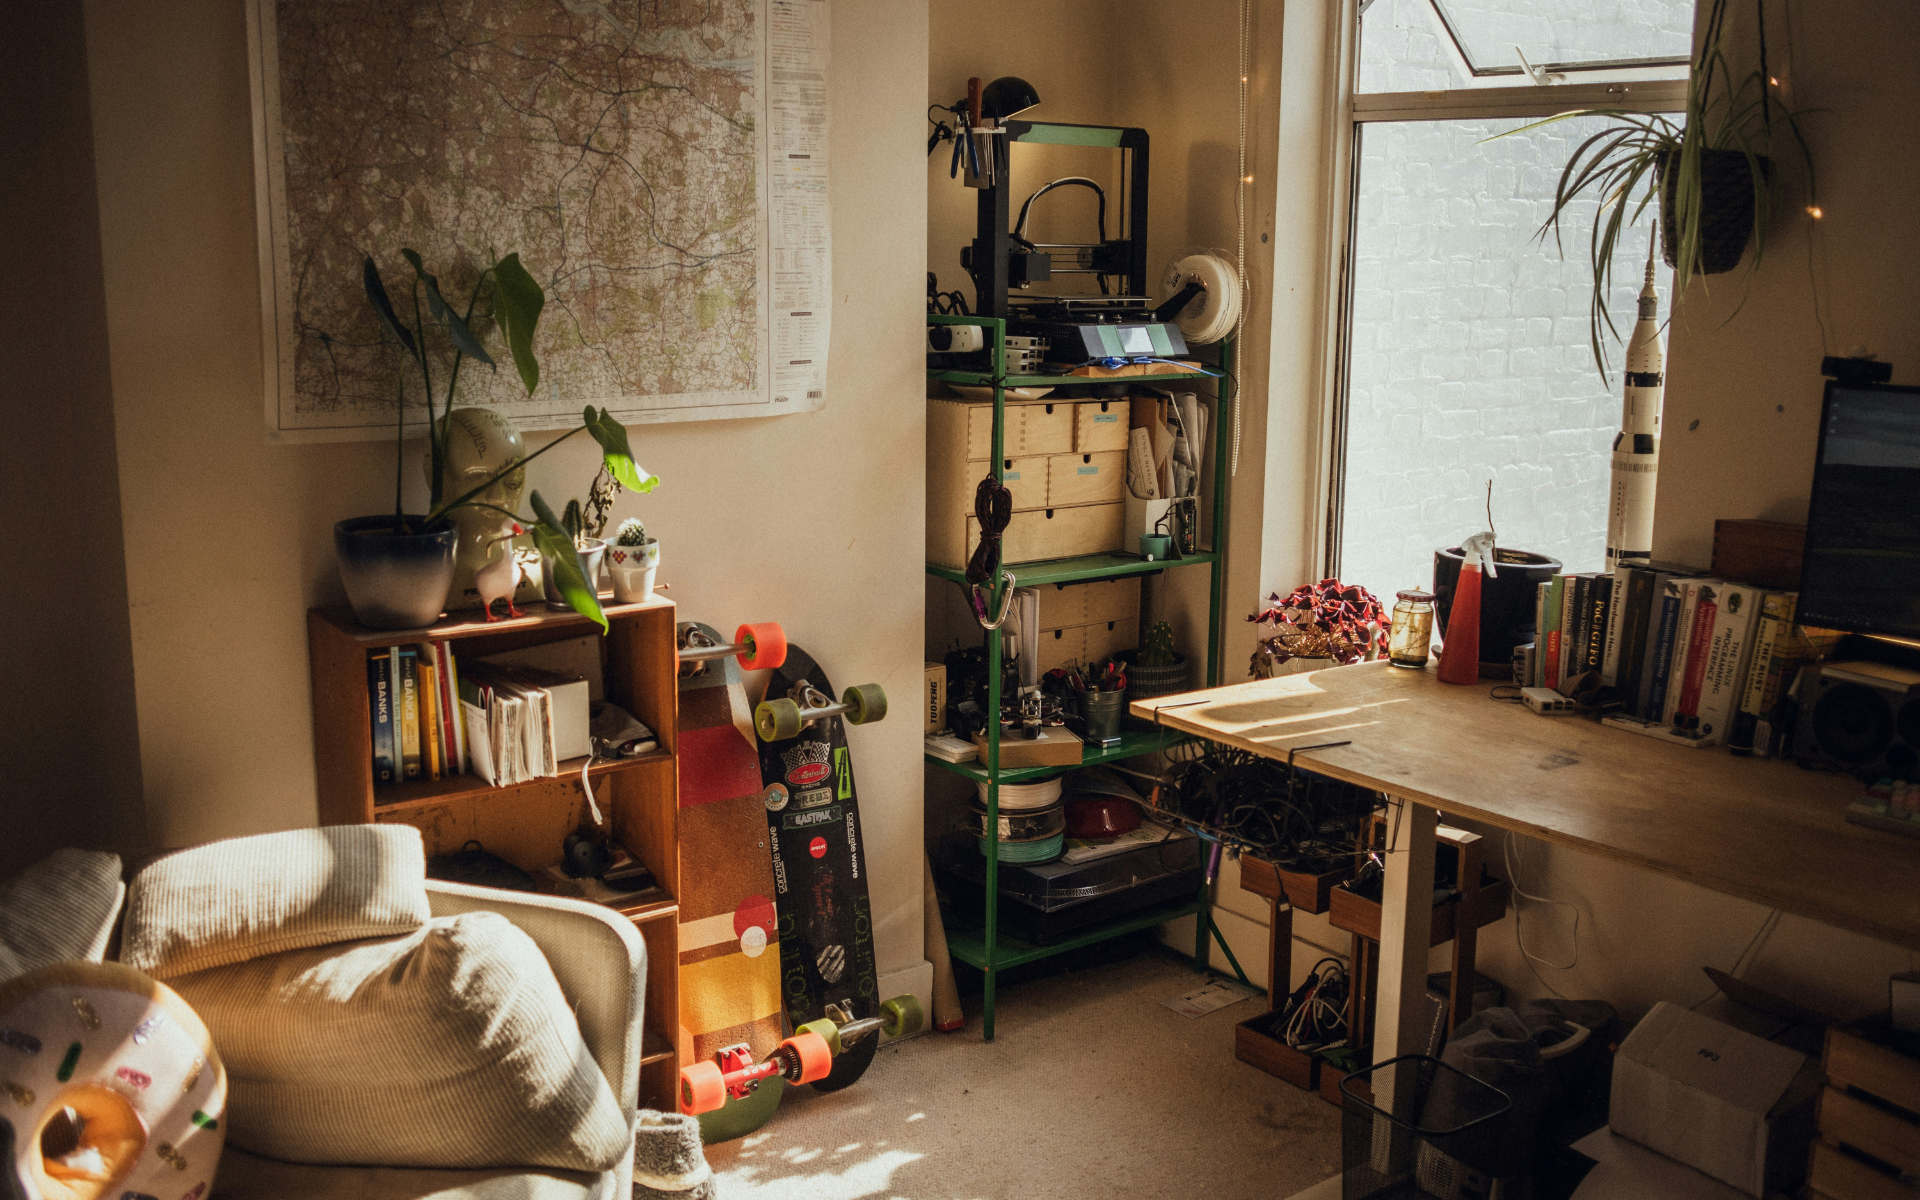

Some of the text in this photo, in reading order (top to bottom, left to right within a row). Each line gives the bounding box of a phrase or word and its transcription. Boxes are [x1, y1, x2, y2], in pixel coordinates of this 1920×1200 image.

[1609, 597, 1620, 637] Hardware
[1680, 608, 1692, 641] Database
[1706, 636, 1721, 681] INTERFACE
[1712, 627, 1733, 695] PROGRAMMING
[1723, 641, 1740, 687] THE LINUX
[1743, 620, 1767, 708] PROGRAMMING LANGUAGE
[1754, 642, 1771, 691] THE RUST
[377, 681, 388, 724] BANKS
[404, 679, 415, 721] BANKS
[930, 681, 938, 724] TUOPENG
[769, 826, 779, 853] wave
[848, 812, 858, 852] concrete
[772, 853, 785, 894] concrete
[851, 853, 859, 879] wave
